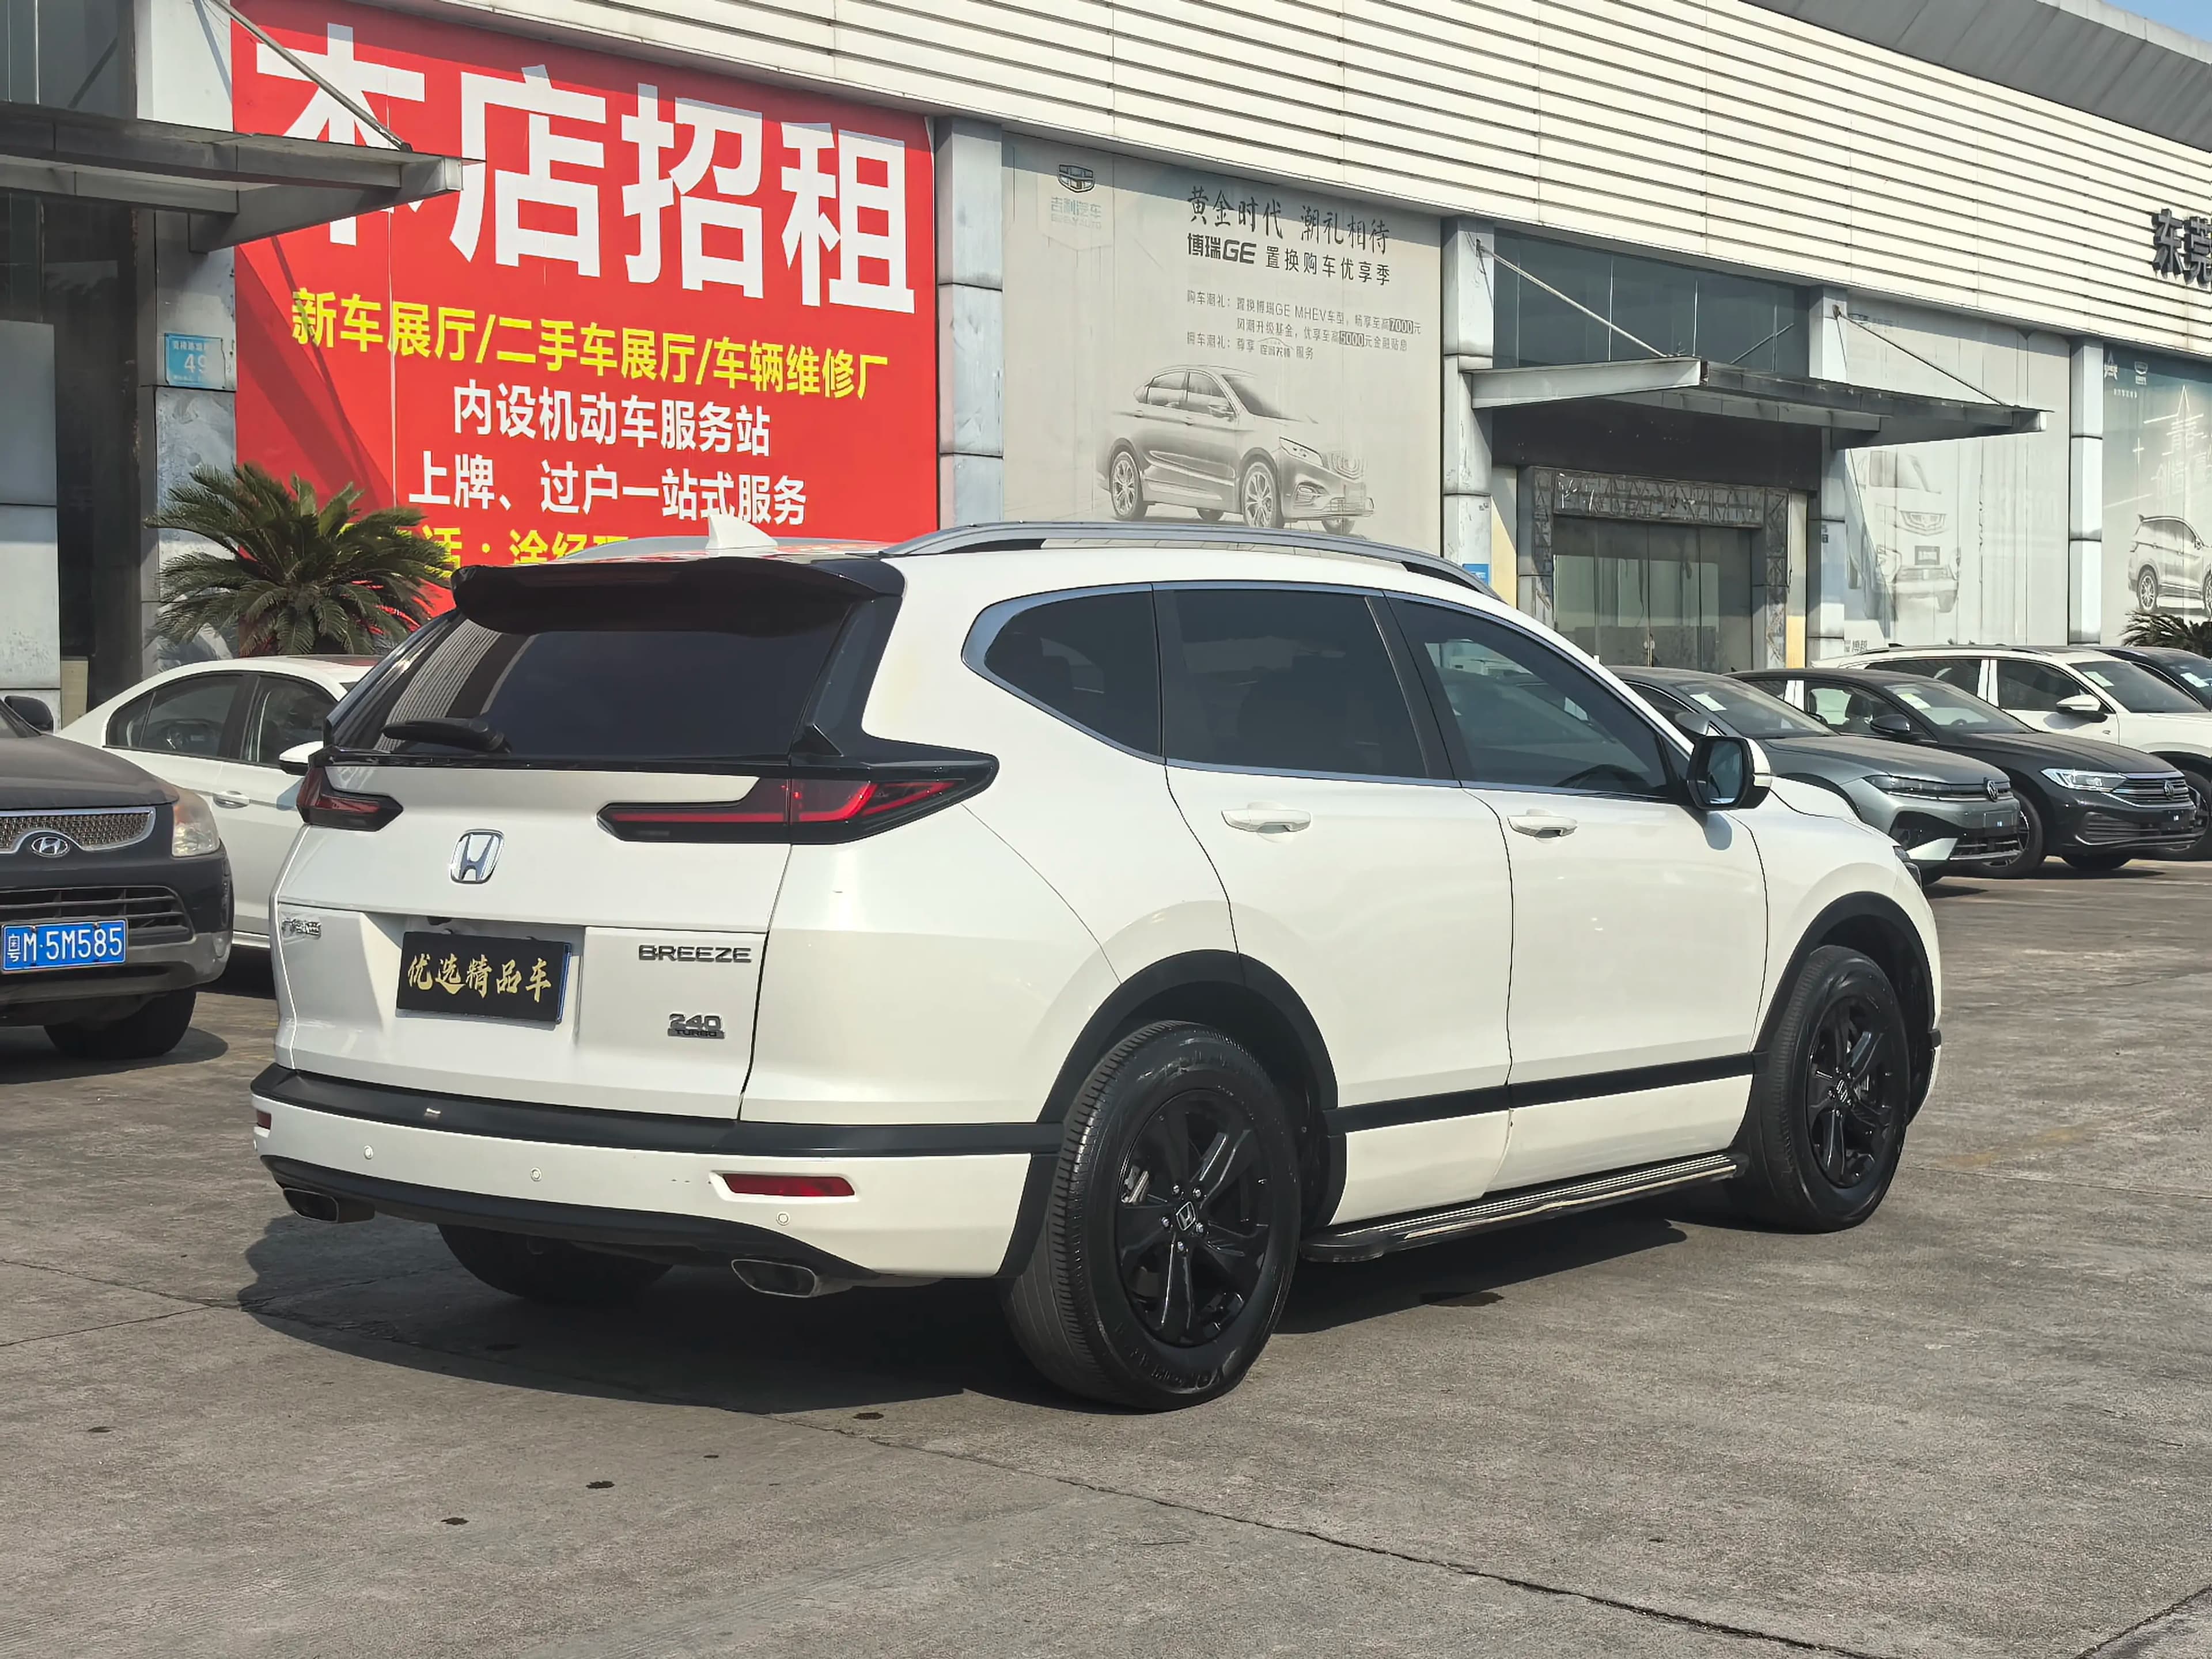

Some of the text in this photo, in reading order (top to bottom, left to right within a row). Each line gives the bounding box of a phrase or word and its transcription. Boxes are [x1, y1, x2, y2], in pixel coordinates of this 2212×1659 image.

[257, 22, 915, 315] 本店招租
[1188, 185, 1389, 255] 黄金时代 潮礼相待
[1187, 233, 1390, 286] 博瑞GE 置换购车优享季
[291, 287, 888, 400] 新车展厅/二手车展厅/车辆维修厂
[453, 378, 771, 457] 内设机动车服务站
[408, 450, 807, 526] 上牌、过户一站式服务
[407, 953, 552, 1002] 优选精品车
[638, 945, 752, 964] BREEZE
[669, 1013, 722, 1031] 240
